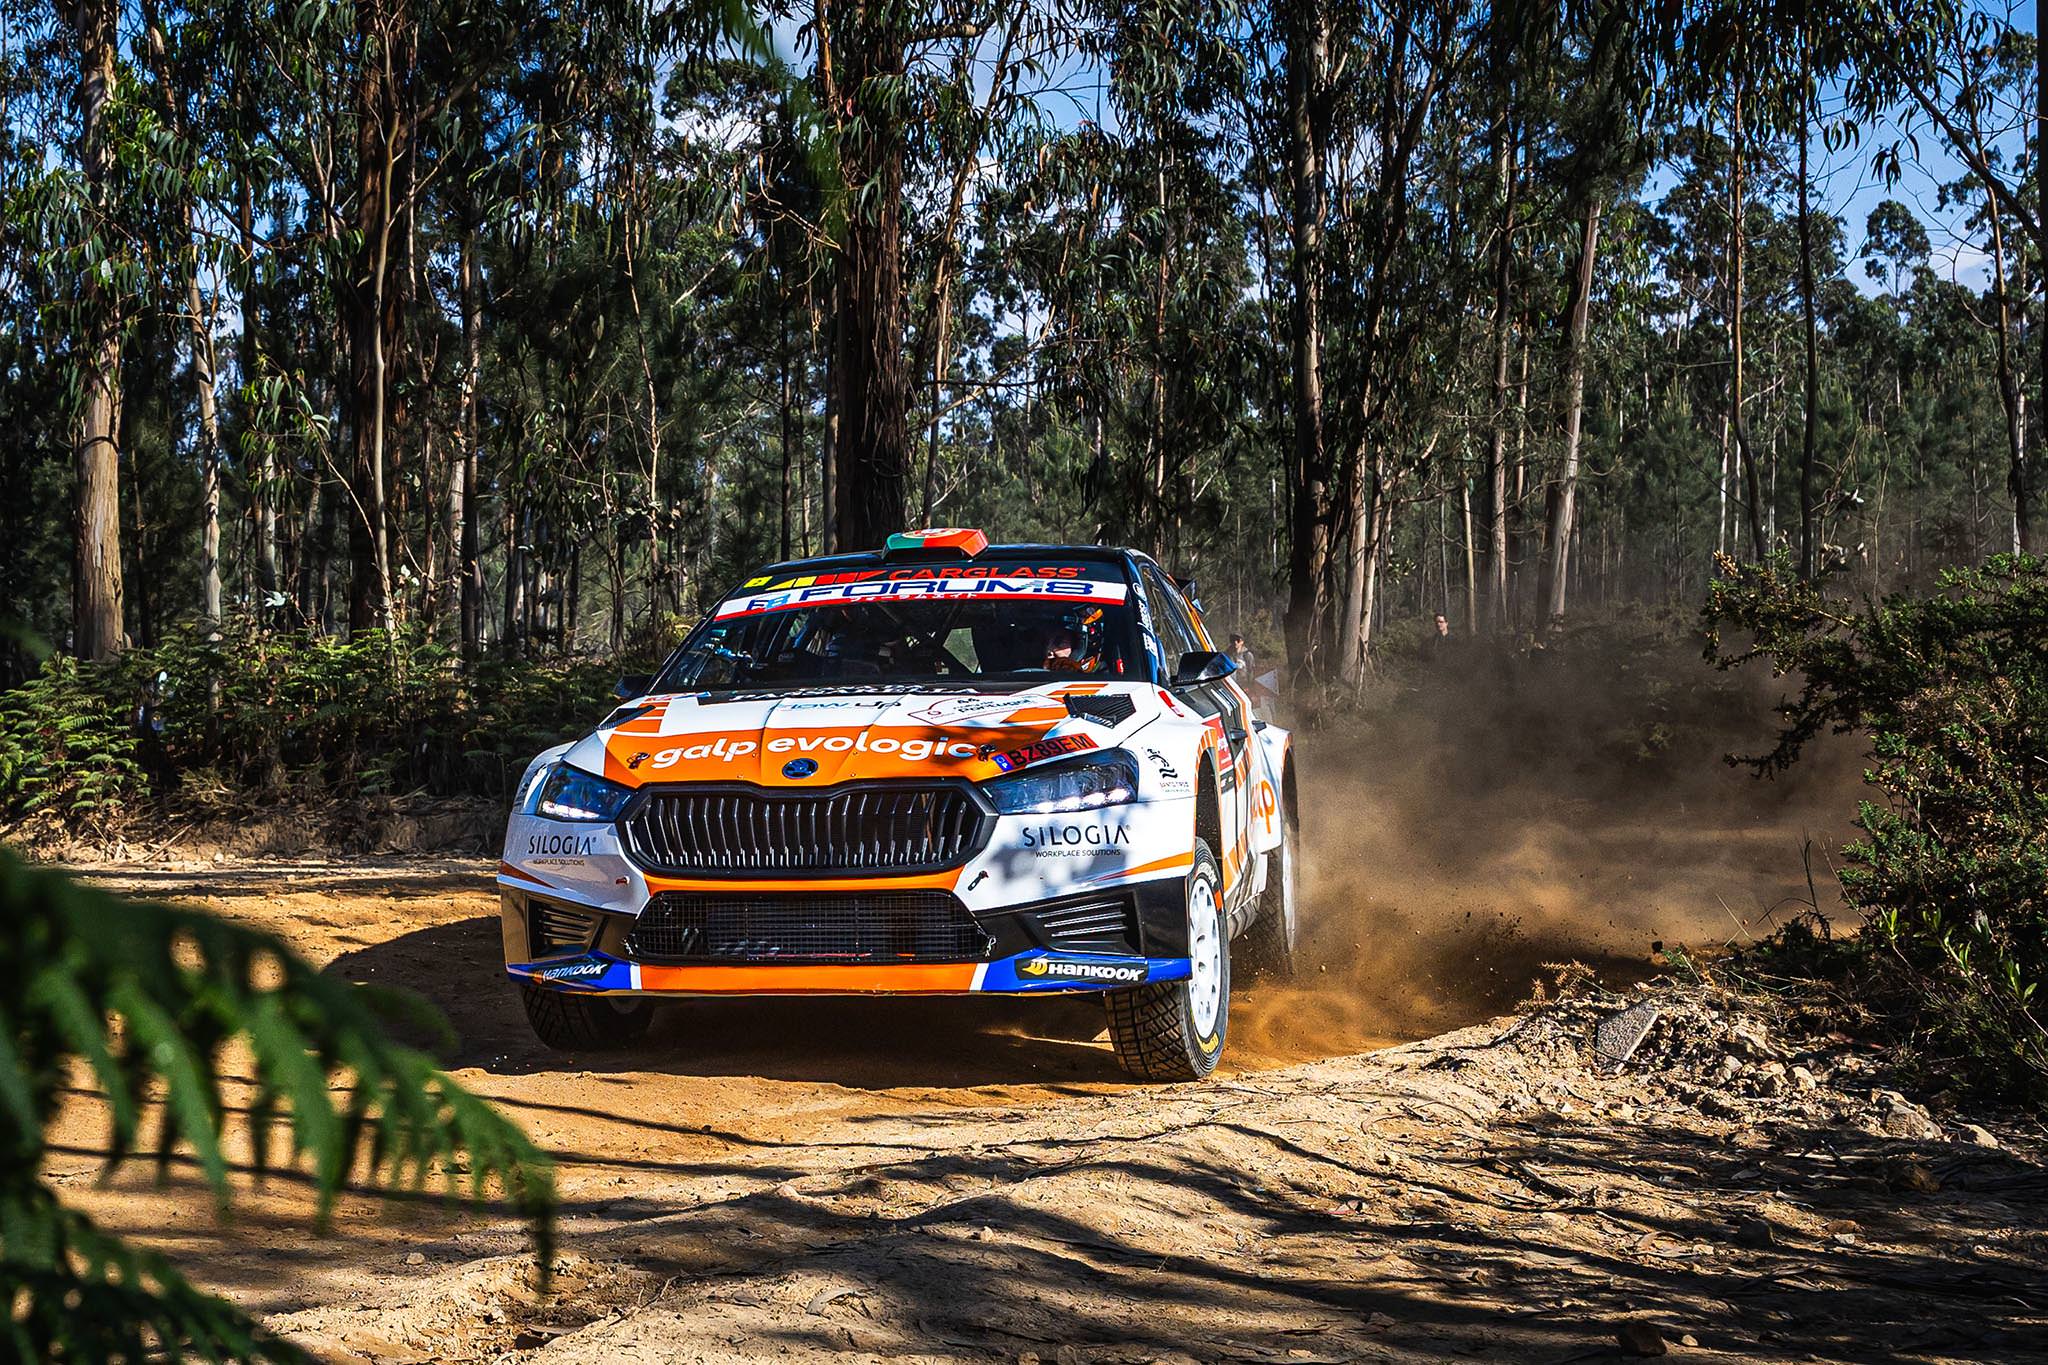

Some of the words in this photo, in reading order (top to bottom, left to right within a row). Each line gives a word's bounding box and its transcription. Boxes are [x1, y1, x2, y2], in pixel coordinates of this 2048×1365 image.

[889, 567, 1080, 581] CARGLASS
[799, 579, 1093, 602] FORUM8
[651, 737, 757, 769] galp
[767, 731, 976, 761] evologic
[1008, 735, 1093, 766] BZ89EM
[1022, 825, 1130, 847] SILOGIA
[1036, 850, 1080, 858] WORKPLACE
[1082, 849, 1121, 857] SOLUTIONS
